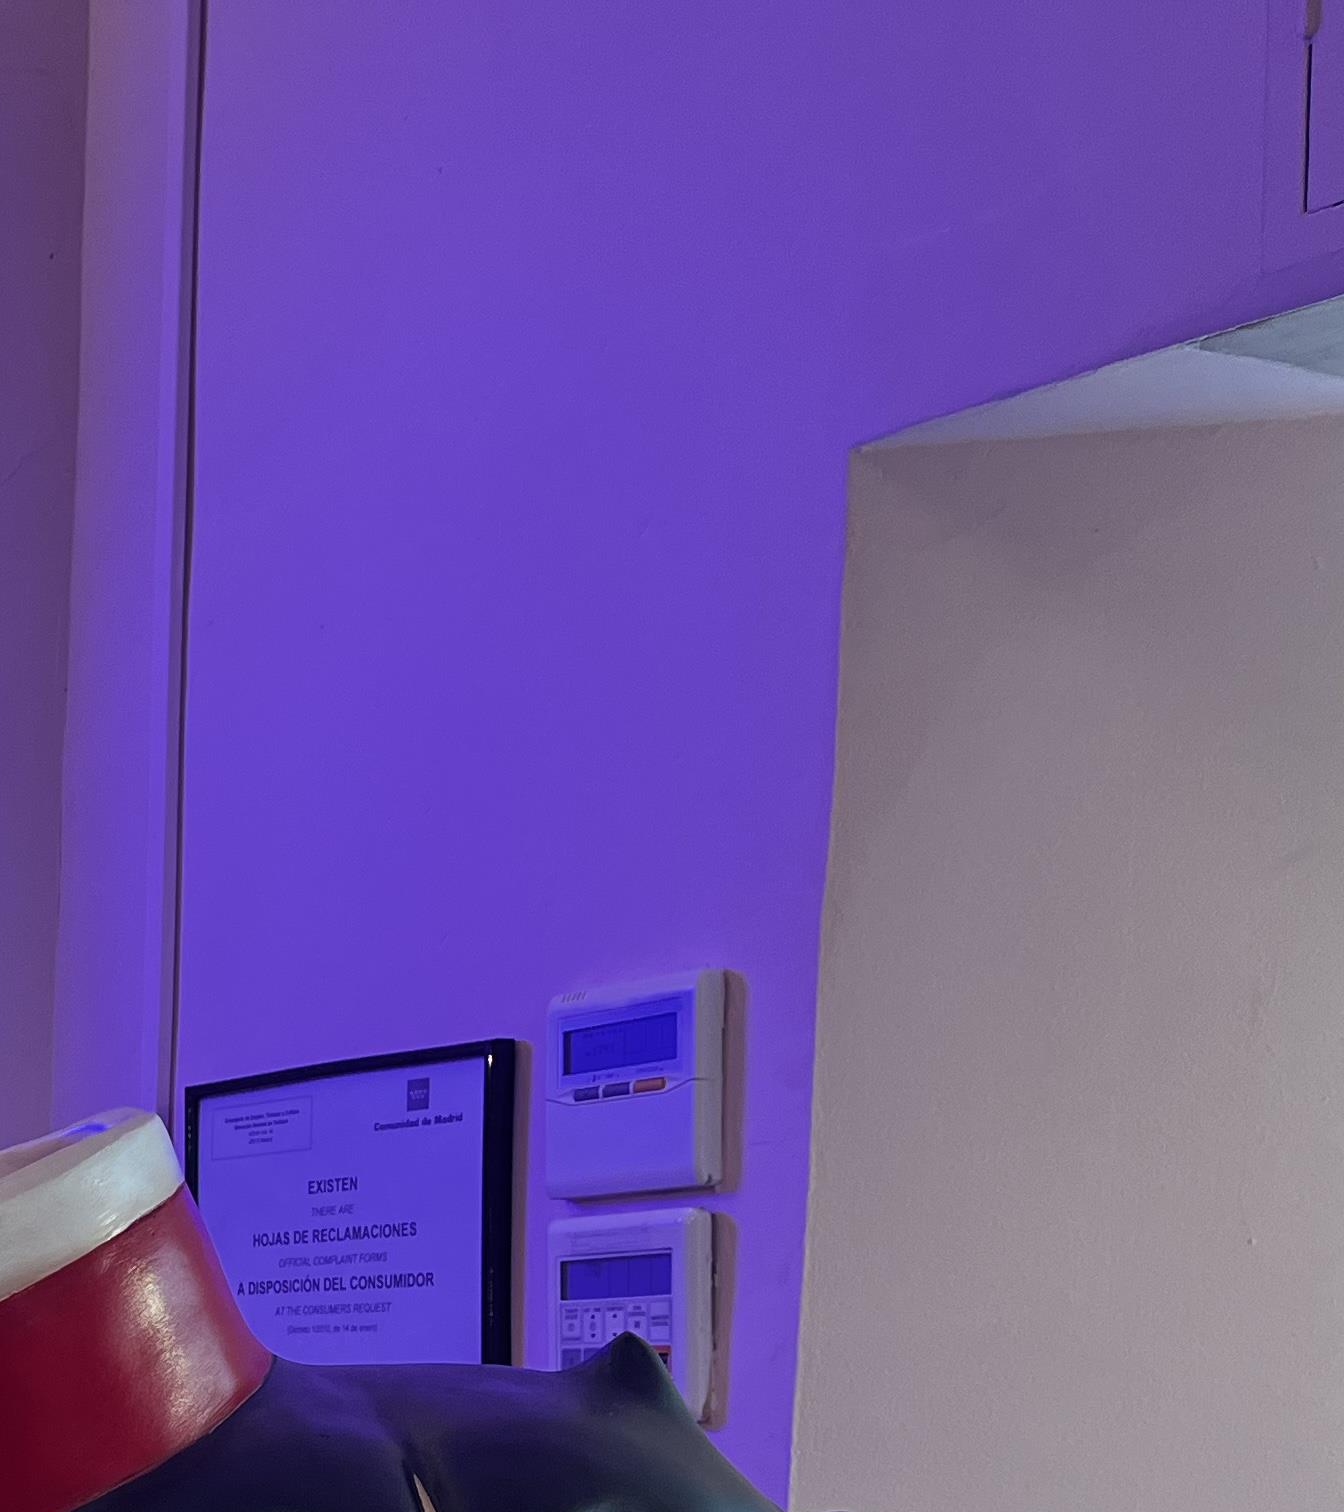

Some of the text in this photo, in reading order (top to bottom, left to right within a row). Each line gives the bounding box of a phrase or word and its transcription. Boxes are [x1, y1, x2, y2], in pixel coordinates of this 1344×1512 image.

[308, 1176, 358, 1195] EXISTEN
[311, 1203, 354, 1217] THERE ARE
[252, 1221, 417, 1248] HOJAS DE RECLAMACIONES
[278, 1252, 388, 1268] OFFICIAL COMPLAINT FORMS
[237, 1271, 435, 1297] A DISPOSICIÓN DEL CONSUMIDOR
[287, 1305, 302, 1317] THE
[353, 1302, 392, 1314] REQUEST
